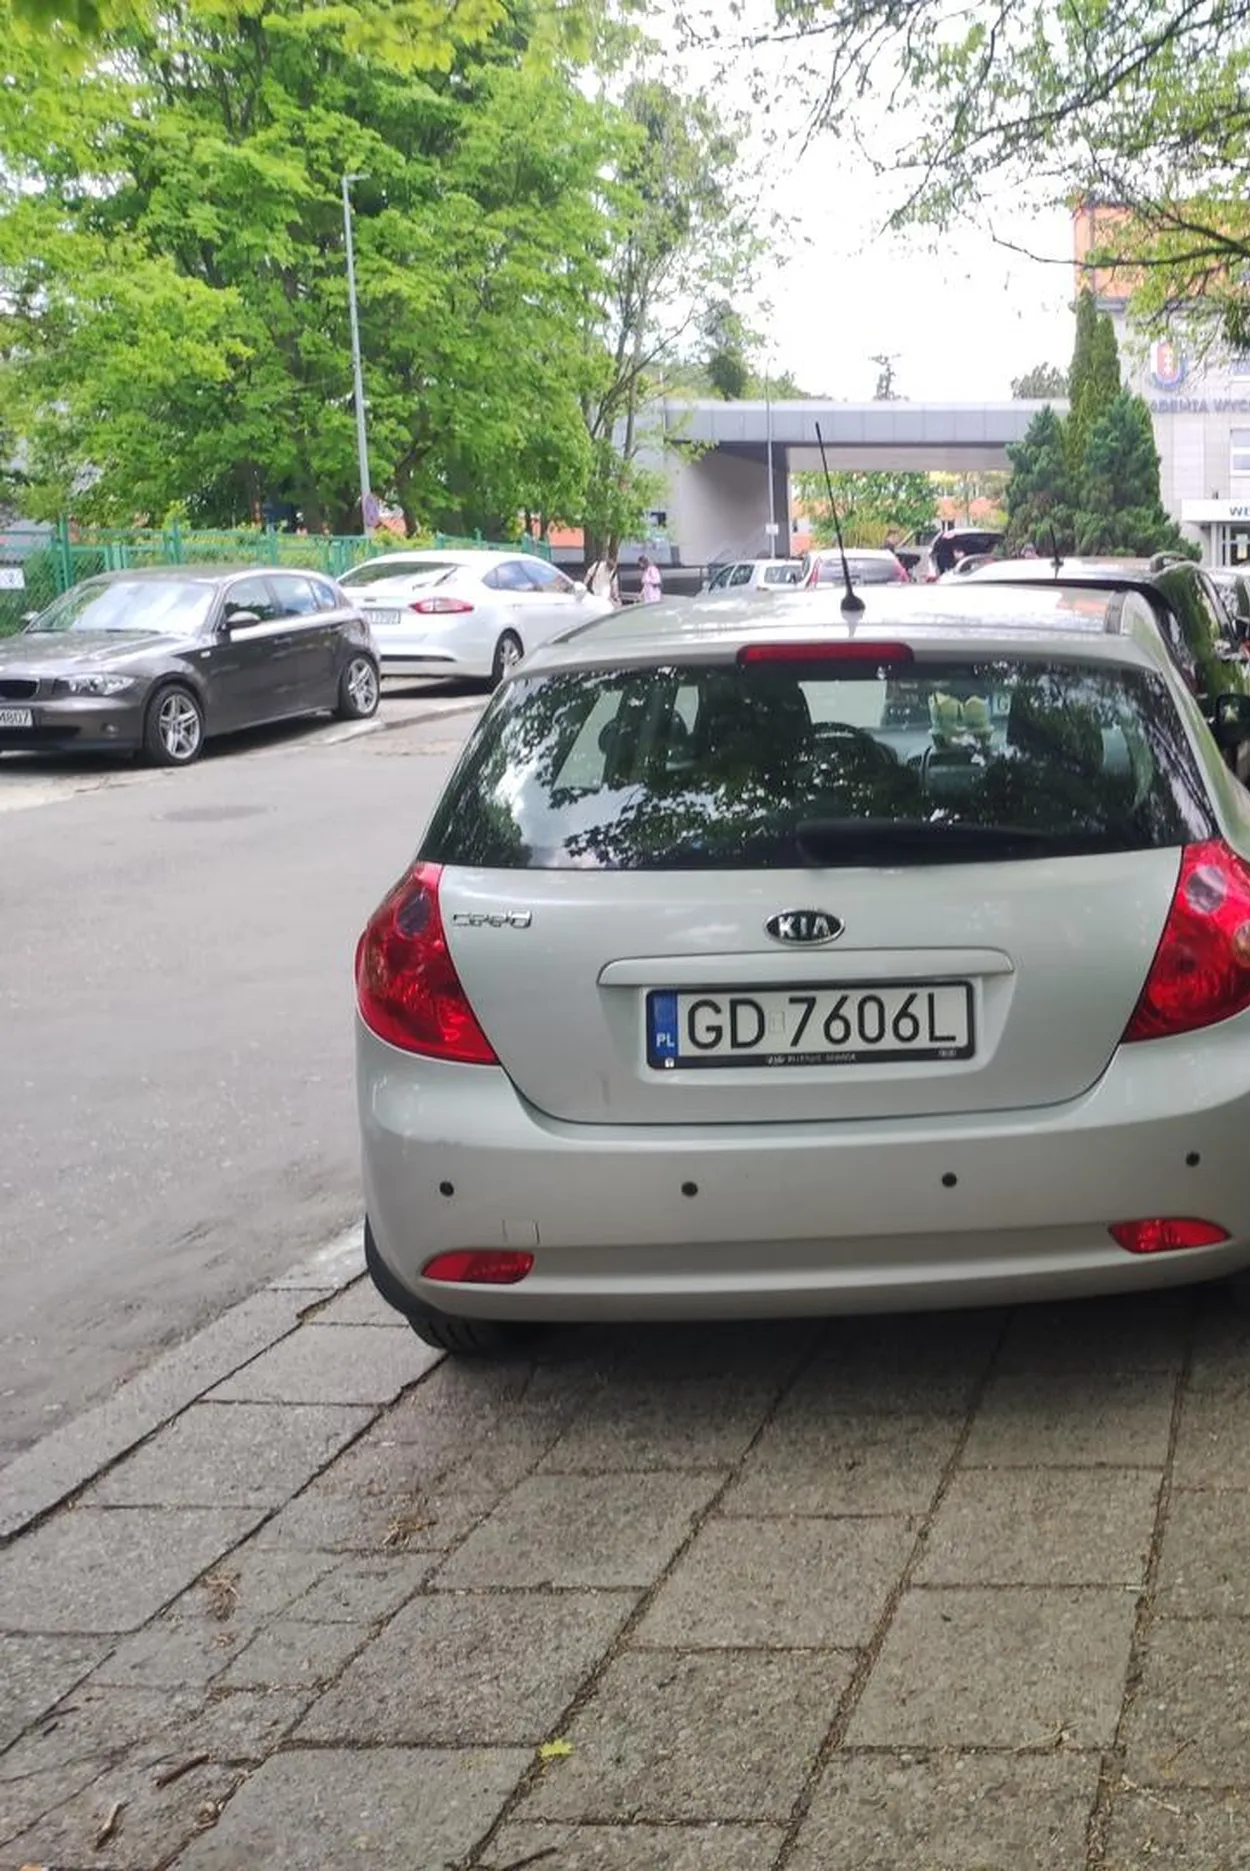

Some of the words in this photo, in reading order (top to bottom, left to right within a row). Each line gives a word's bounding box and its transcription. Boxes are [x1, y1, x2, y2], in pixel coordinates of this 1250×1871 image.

[779, 915, 831, 938] KIA
[687, 997, 766, 1050] GD
[788, 992, 957, 1048] 7606L
[656, 1032, 676, 1049] PL
